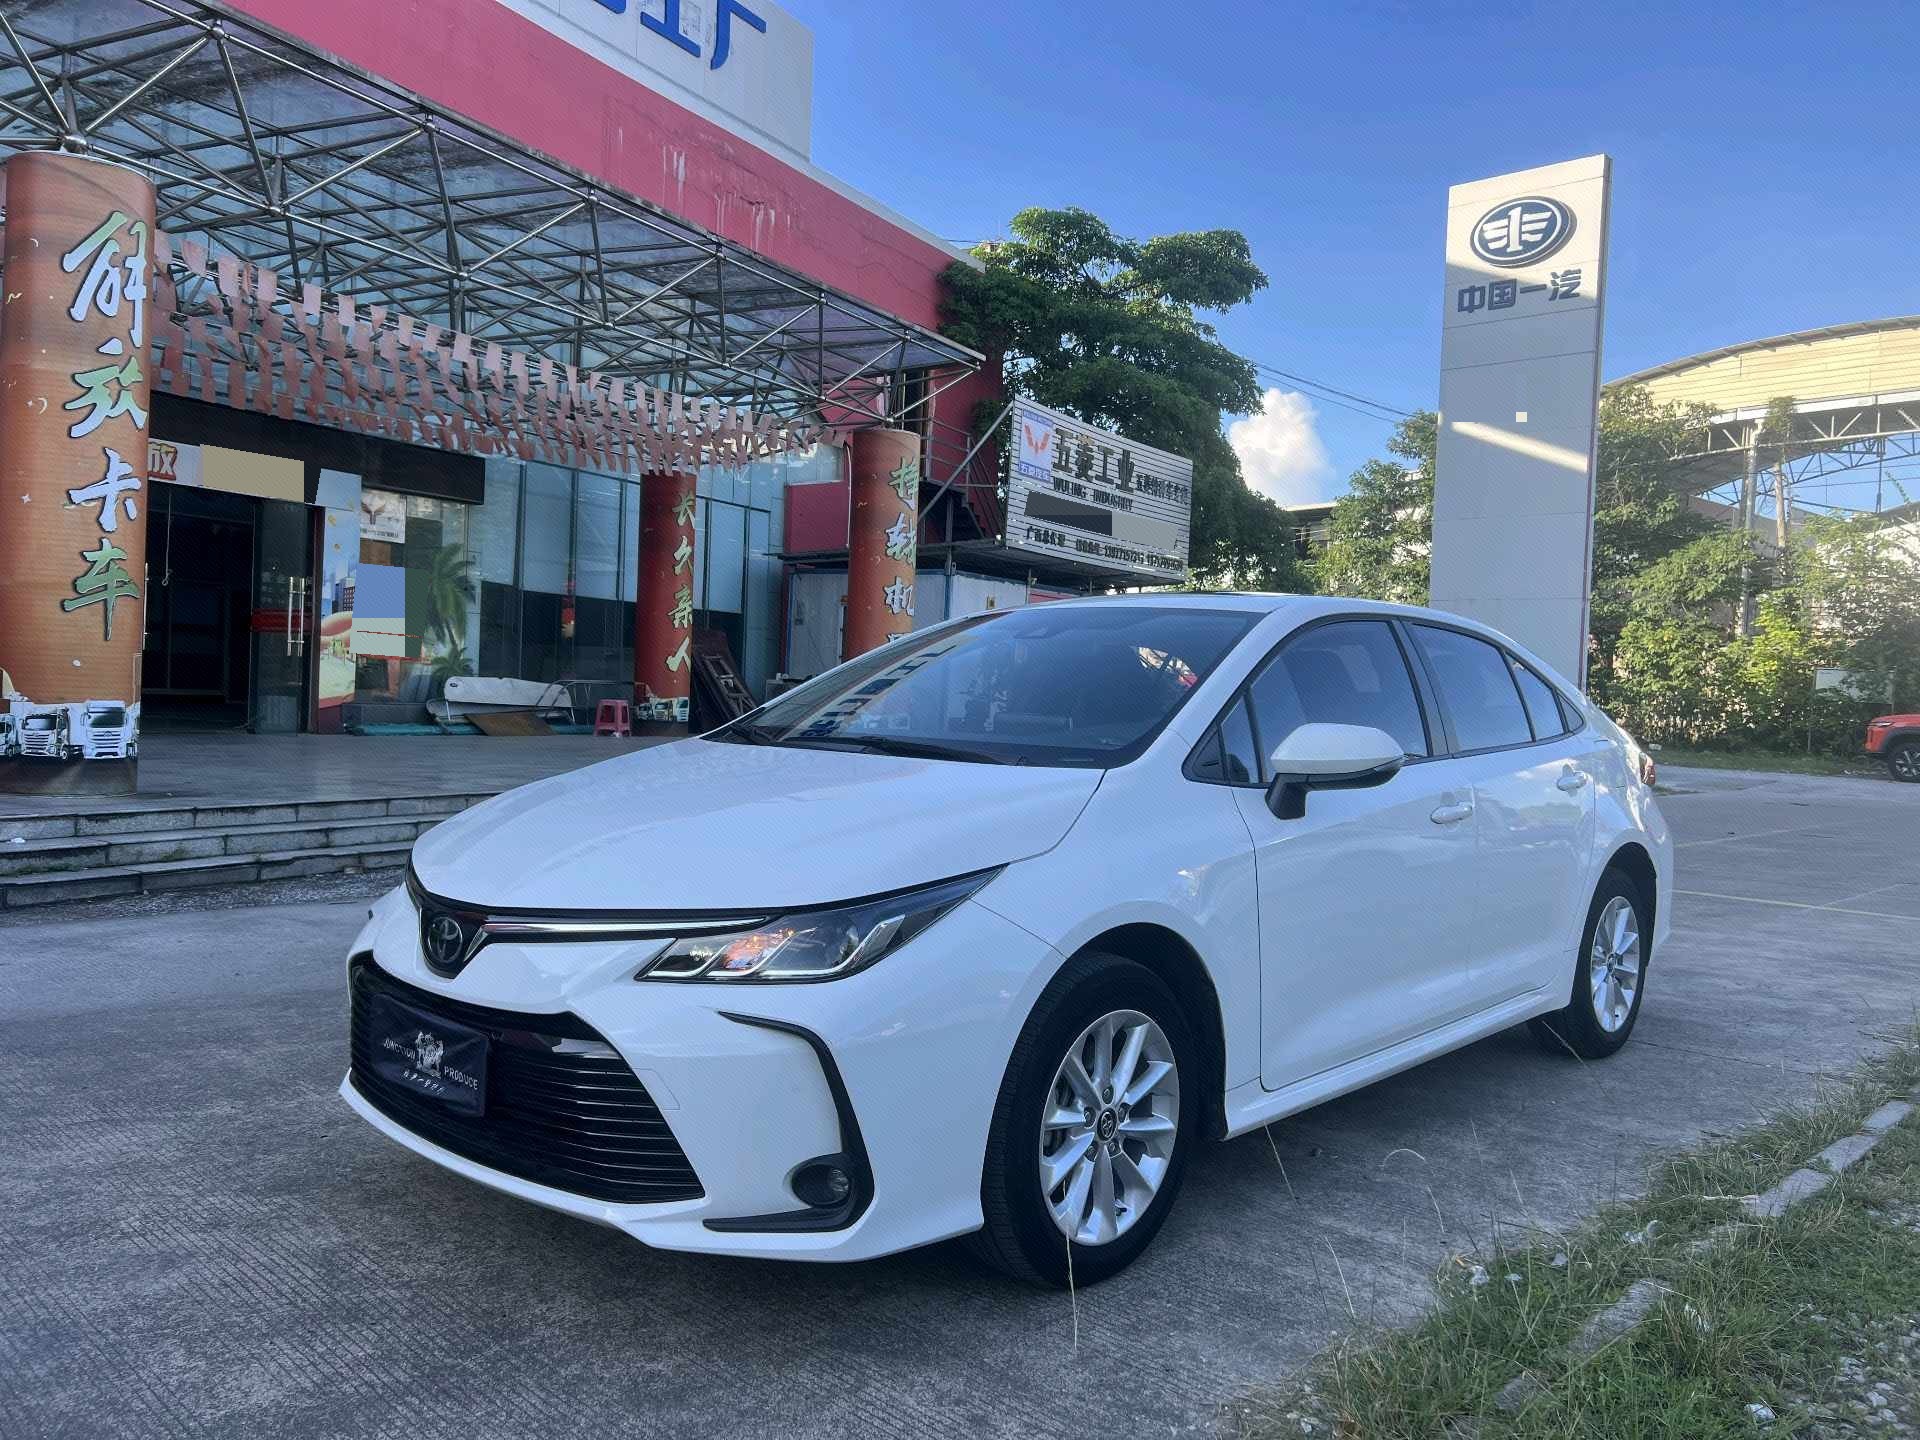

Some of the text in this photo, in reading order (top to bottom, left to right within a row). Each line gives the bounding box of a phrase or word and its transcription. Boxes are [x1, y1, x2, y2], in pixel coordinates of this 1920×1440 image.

[592, 0, 767, 70] 工厂
[1457, 268, 1582, 313] 中国一汽
[62, 210, 148, 642] 解放卡车
[1053, 427, 1136, 493] 五菱工业
[1053, 476, 1087, 498] WULING
[384, 1038, 416, 1060] JUNCTION
[444, 1065, 478, 1090] PRODUCE
